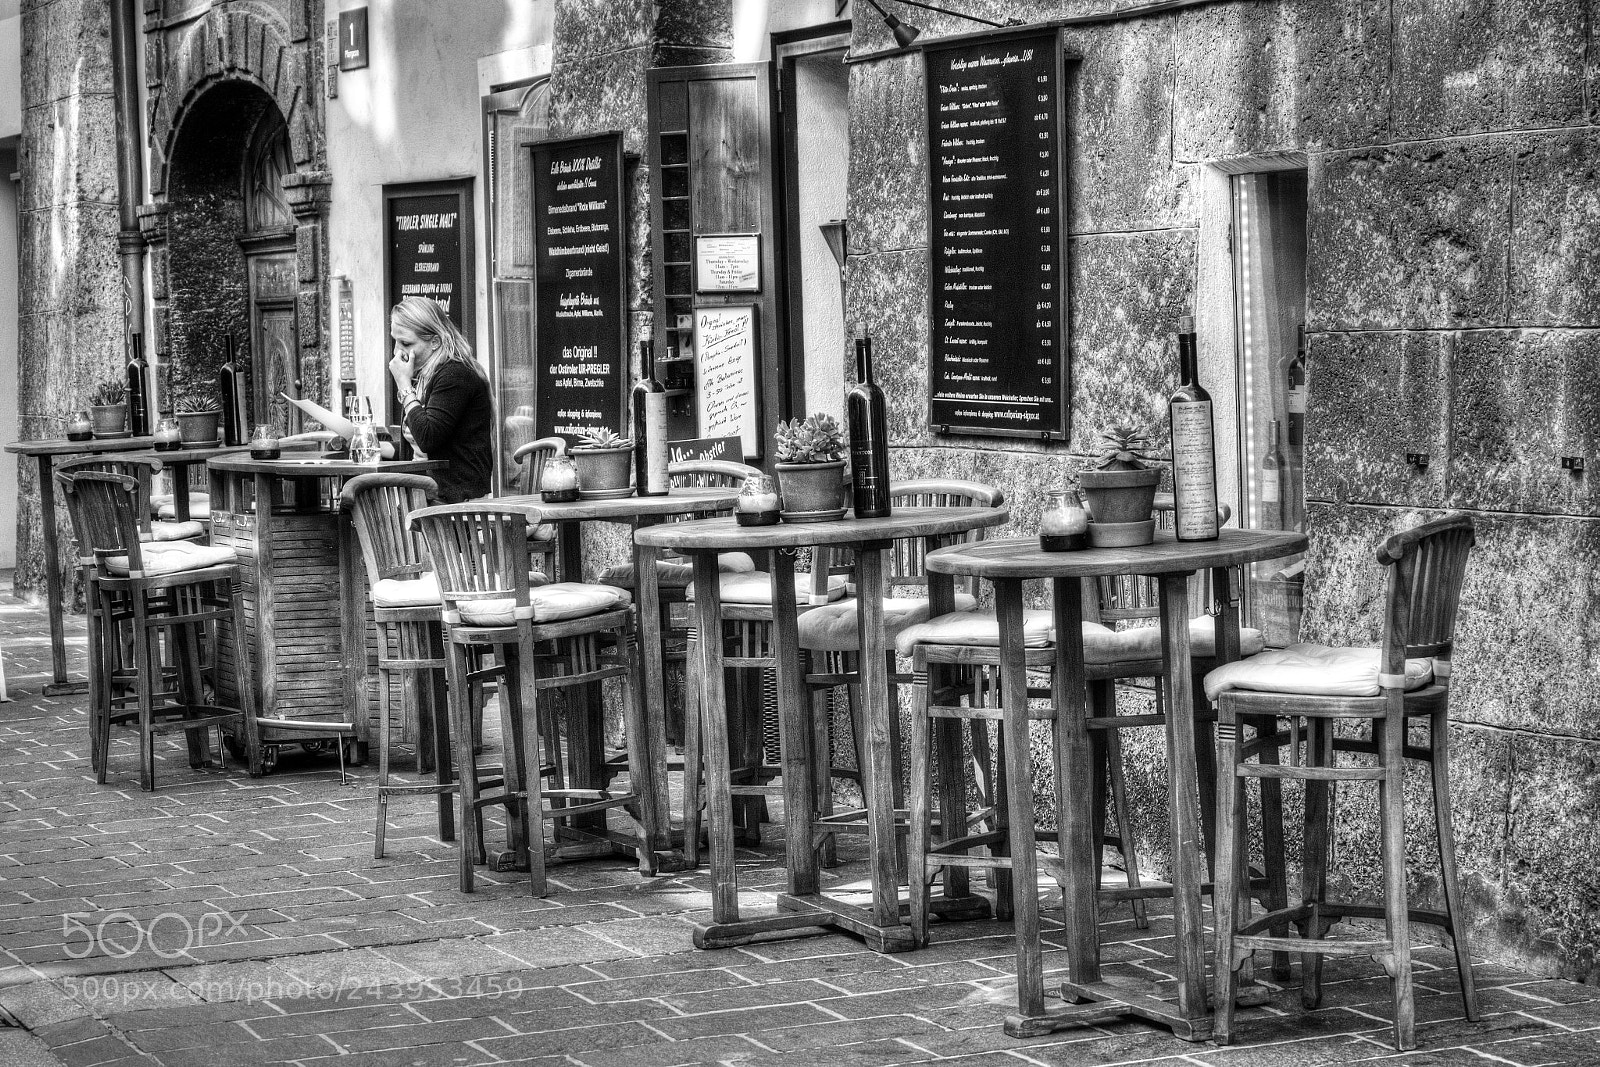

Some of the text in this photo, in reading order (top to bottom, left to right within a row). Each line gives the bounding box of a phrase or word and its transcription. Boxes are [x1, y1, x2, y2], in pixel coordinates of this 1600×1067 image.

[349, 22, 354, 46] 1
[419, 213, 439, 229] SINGLE
[562, 345, 572, 358] das
[572, 345, 592, 361] Original
